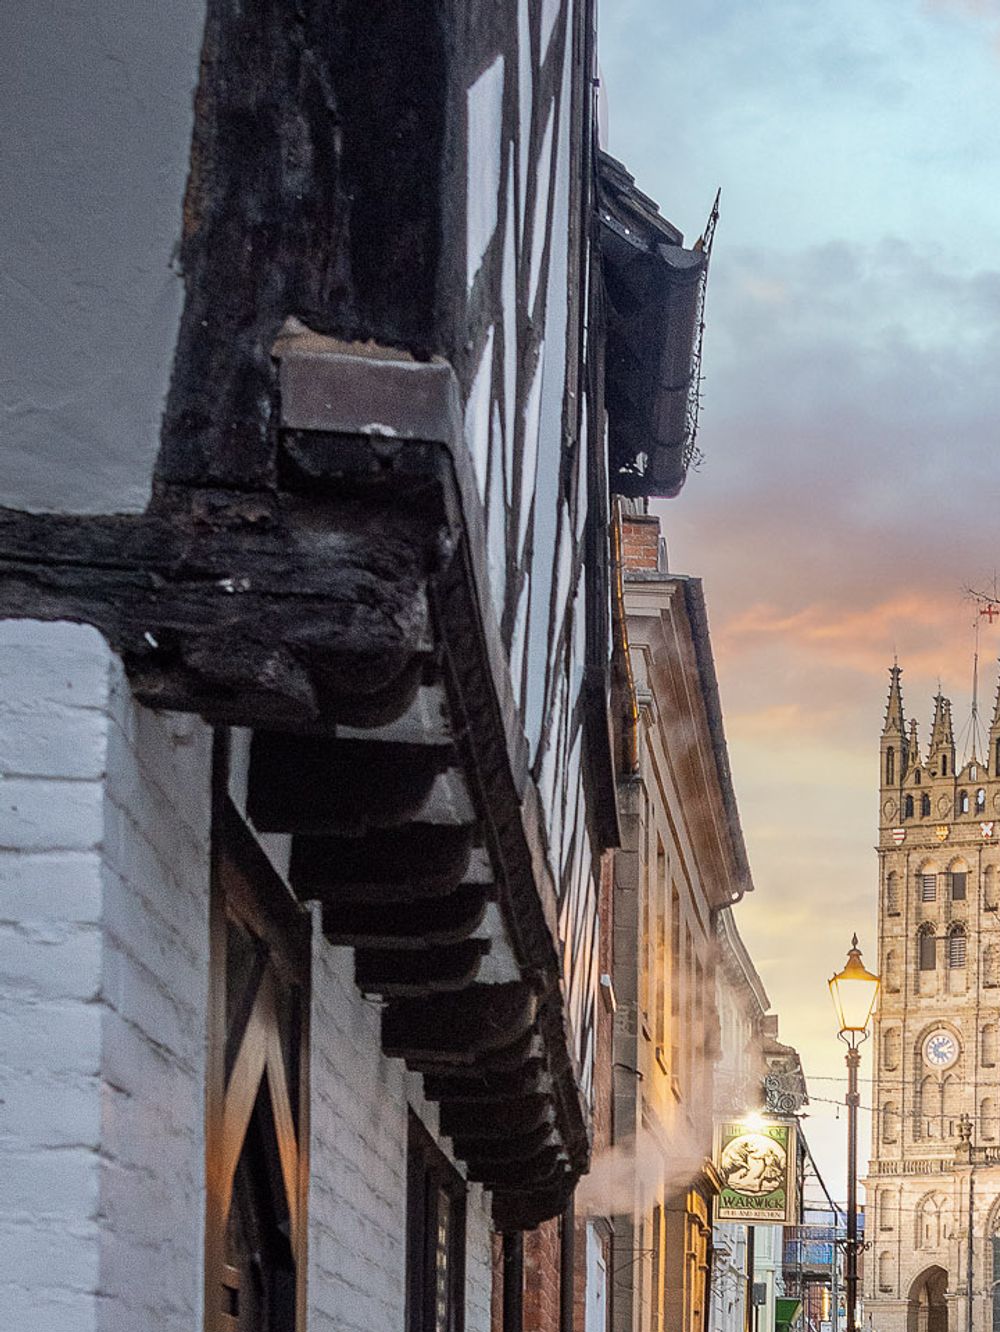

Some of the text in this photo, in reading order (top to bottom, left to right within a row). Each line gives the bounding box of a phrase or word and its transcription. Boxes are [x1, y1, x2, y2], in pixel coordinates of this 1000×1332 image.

[768, 1128, 785, 1137] OF
[723, 1196, 783, 1209] WARWICK
[739, 1210, 753, 1218] AND
[754, 1211, 782, 1219] KITCHEN
